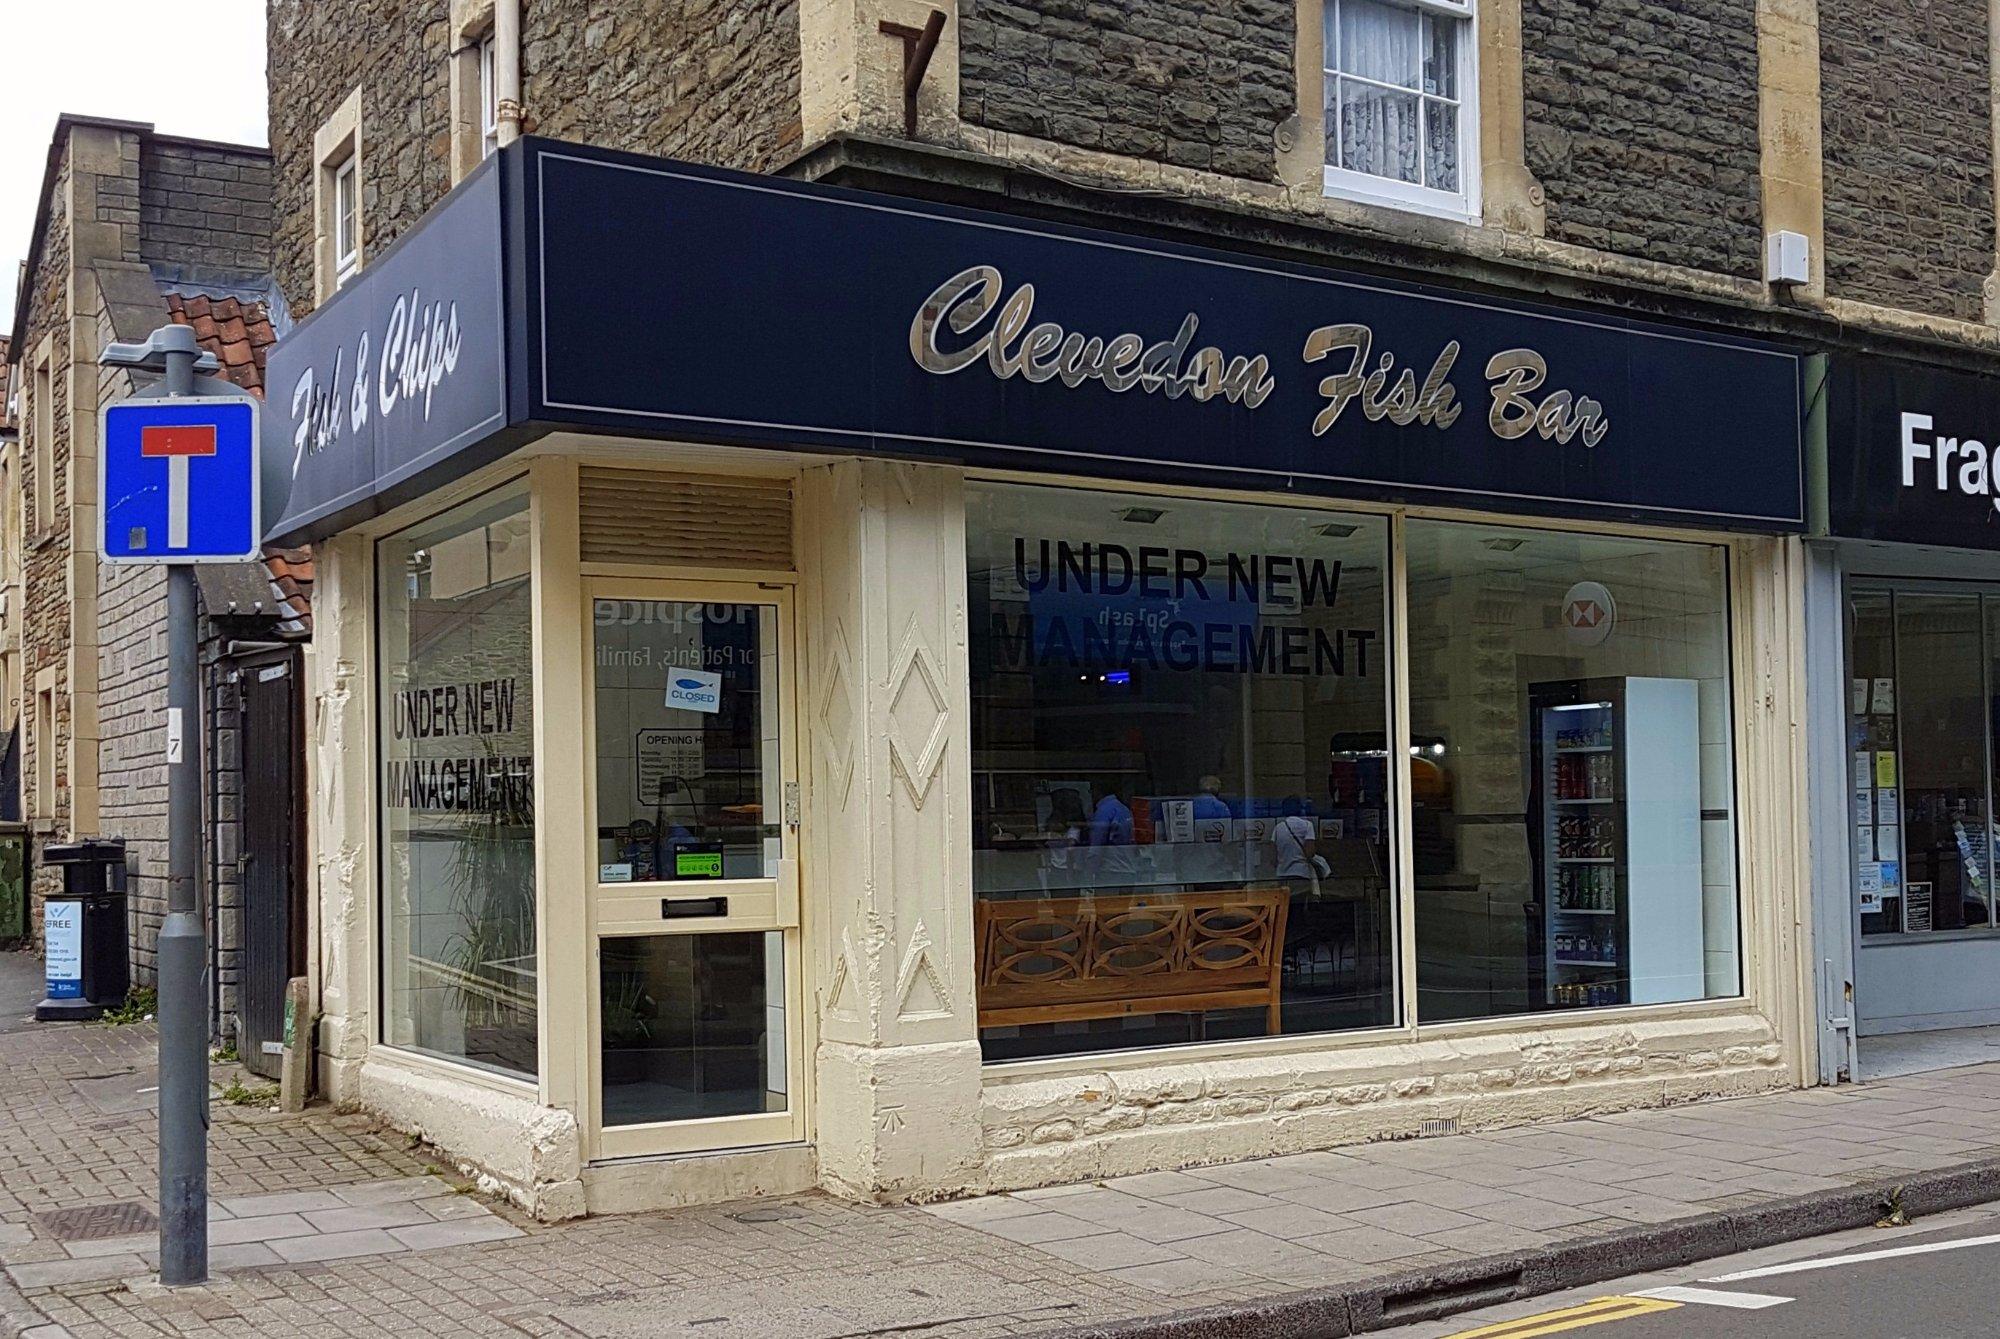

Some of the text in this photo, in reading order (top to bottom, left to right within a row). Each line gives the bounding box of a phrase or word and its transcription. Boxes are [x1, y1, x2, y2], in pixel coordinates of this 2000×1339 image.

[290, 286, 462, 481] Fish & Chips
[909, 265, 1609, 448] Clevedon Fish Bar
[1013, 537, 1343, 608] UNDER NEW
[991, 612, 1377, 678] MANAGEMENT
[393, 677, 516, 741] UNDER NEW
[671, 689, 716, 703] CLOSED
[646, 735, 693, 745] OPENING
[386, 756, 533, 811] MANAGEMENT
